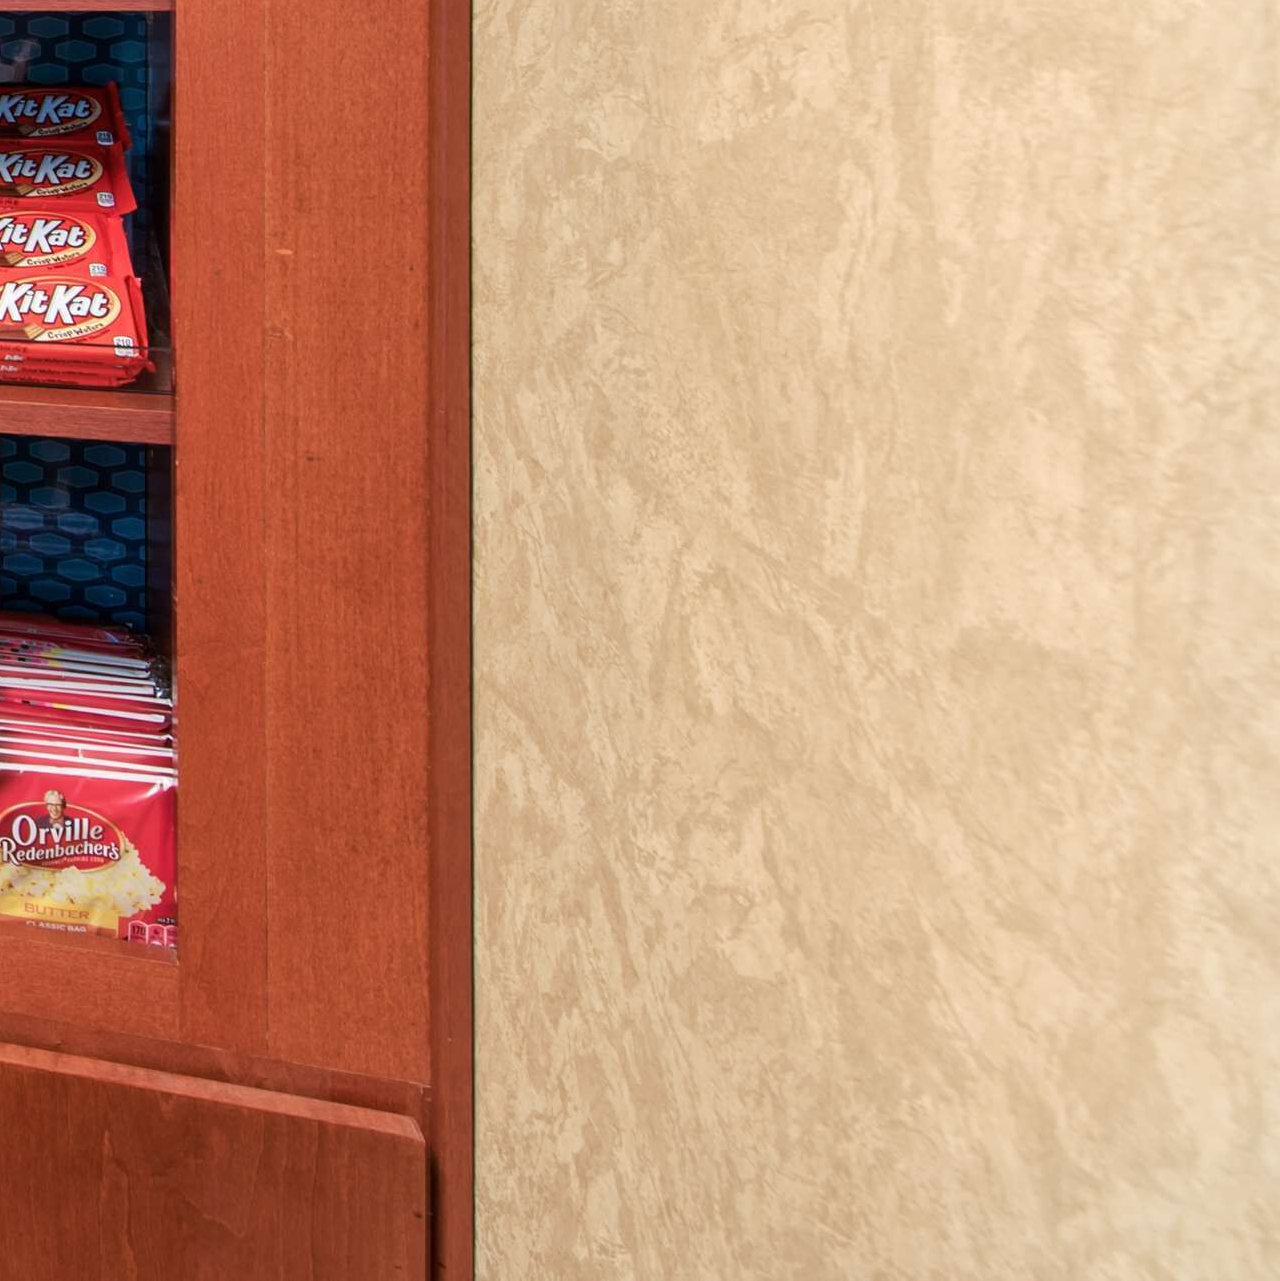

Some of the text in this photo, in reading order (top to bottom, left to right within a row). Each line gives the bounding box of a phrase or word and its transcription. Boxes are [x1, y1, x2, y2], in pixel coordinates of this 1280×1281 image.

[47, 321, 105, 340] Crisp Wafers
[12, 814, 104, 846] Orville
[24, 903, 90, 919] BUTTER
[25, 920, 87, 933] CLASSIC BAG
